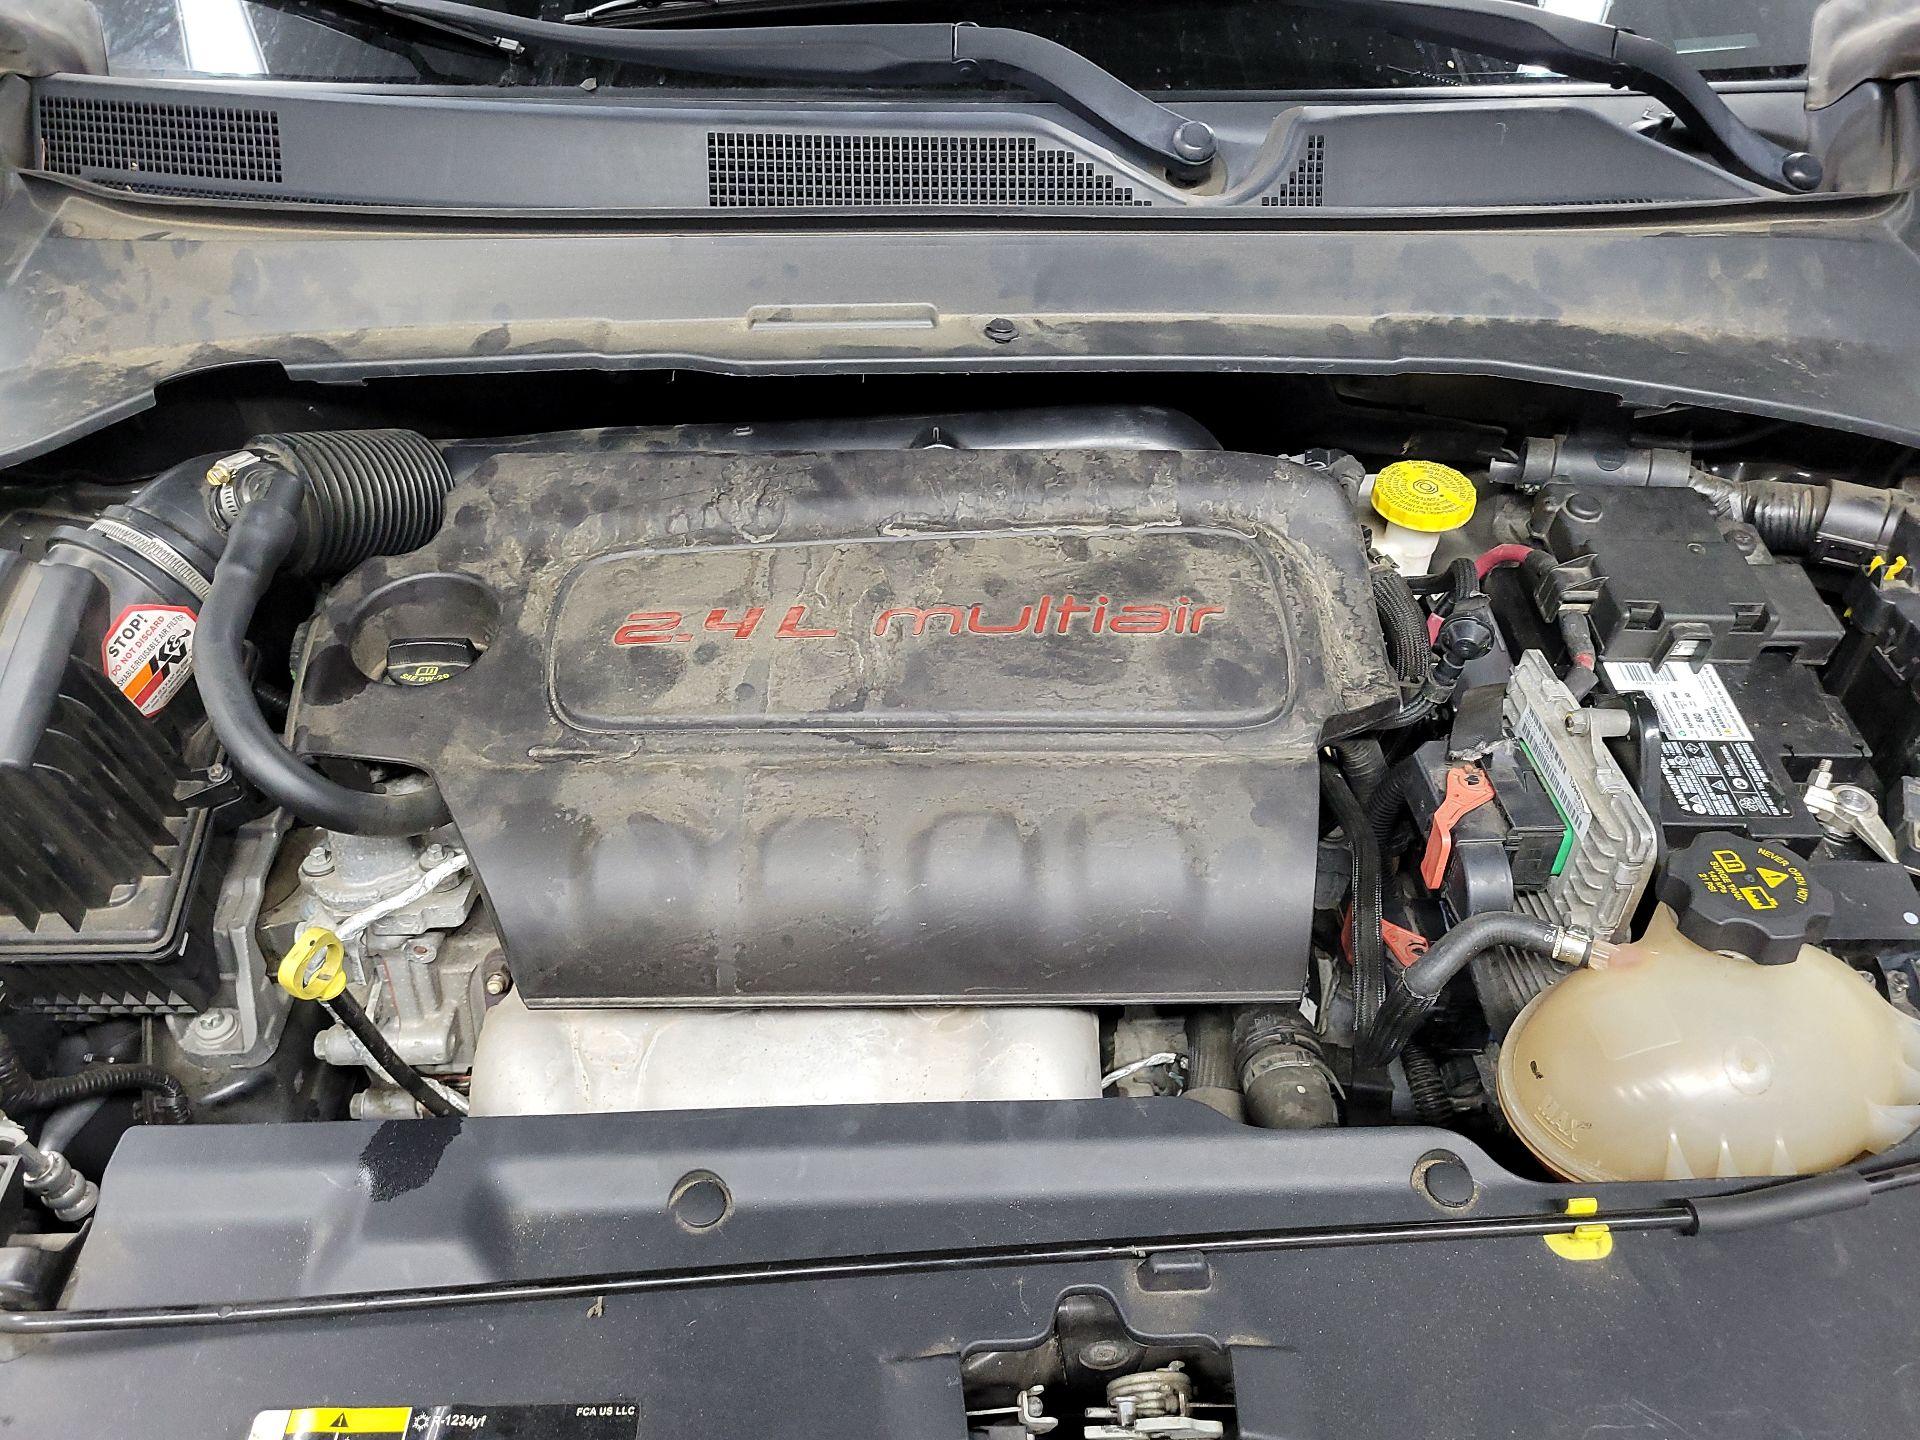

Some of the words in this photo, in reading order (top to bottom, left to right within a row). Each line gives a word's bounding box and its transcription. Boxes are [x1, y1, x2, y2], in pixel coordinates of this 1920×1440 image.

[109, 613, 148, 658] STOP!
[873, 595, 1225, 636] multiair
[112, 663, 122, 677] DO
[121, 647, 137, 665] NOT
[135, 615, 165, 649] DISCARD
[117, 637, 161, 687] SHABLE/REUSABLE
[159, 629, 168, 641] AIR
[167, 614, 186, 630] FILTER
[148, 628, 192, 681] K&N
[400, 673, 418, 682] SAE
[419, 673, 450, 682] 0W-20
[1698, 872, 1709, 882] 21
[1704, 880, 1718, 893] PSI
[1708, 870, 1721, 883] 145
[1710, 861, 1732, 884] SURGE
[1727, 882, 1745, 901] TANK
[1758, 847, 1790, 867] NEVER
[1788, 867, 1807, 886] OPEN
[1538, 1095, 1579, 1142] MAX
[432, 1412, 488, 1430] R-1234yf
[575, 1406, 597, 1417] FCA
[599, 1405, 613, 1416] US
[615, 1405, 636, 1416] LLC
